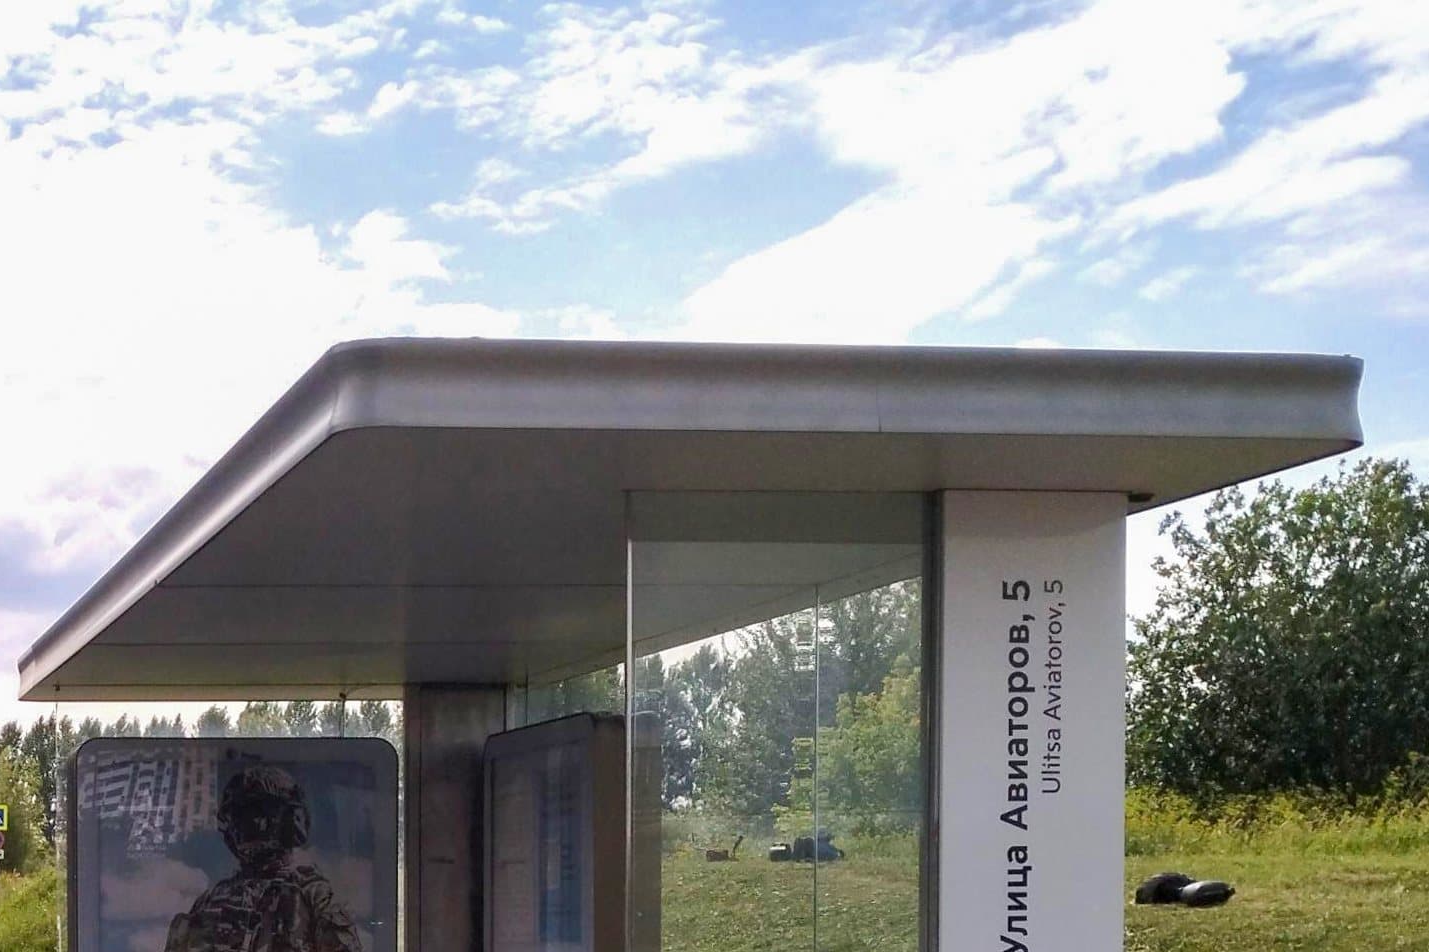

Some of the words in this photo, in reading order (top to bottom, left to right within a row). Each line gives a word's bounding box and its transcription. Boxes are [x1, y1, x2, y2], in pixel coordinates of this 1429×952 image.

[1002, 580, 1031, 601] 5
[1044, 579, 1063, 594] 5
[1043, 602, 1066, 720] Aviatorov,
[1000, 613, 1036, 831] Авиаторов,
[1041, 728, 1061, 793] Ulitsa
